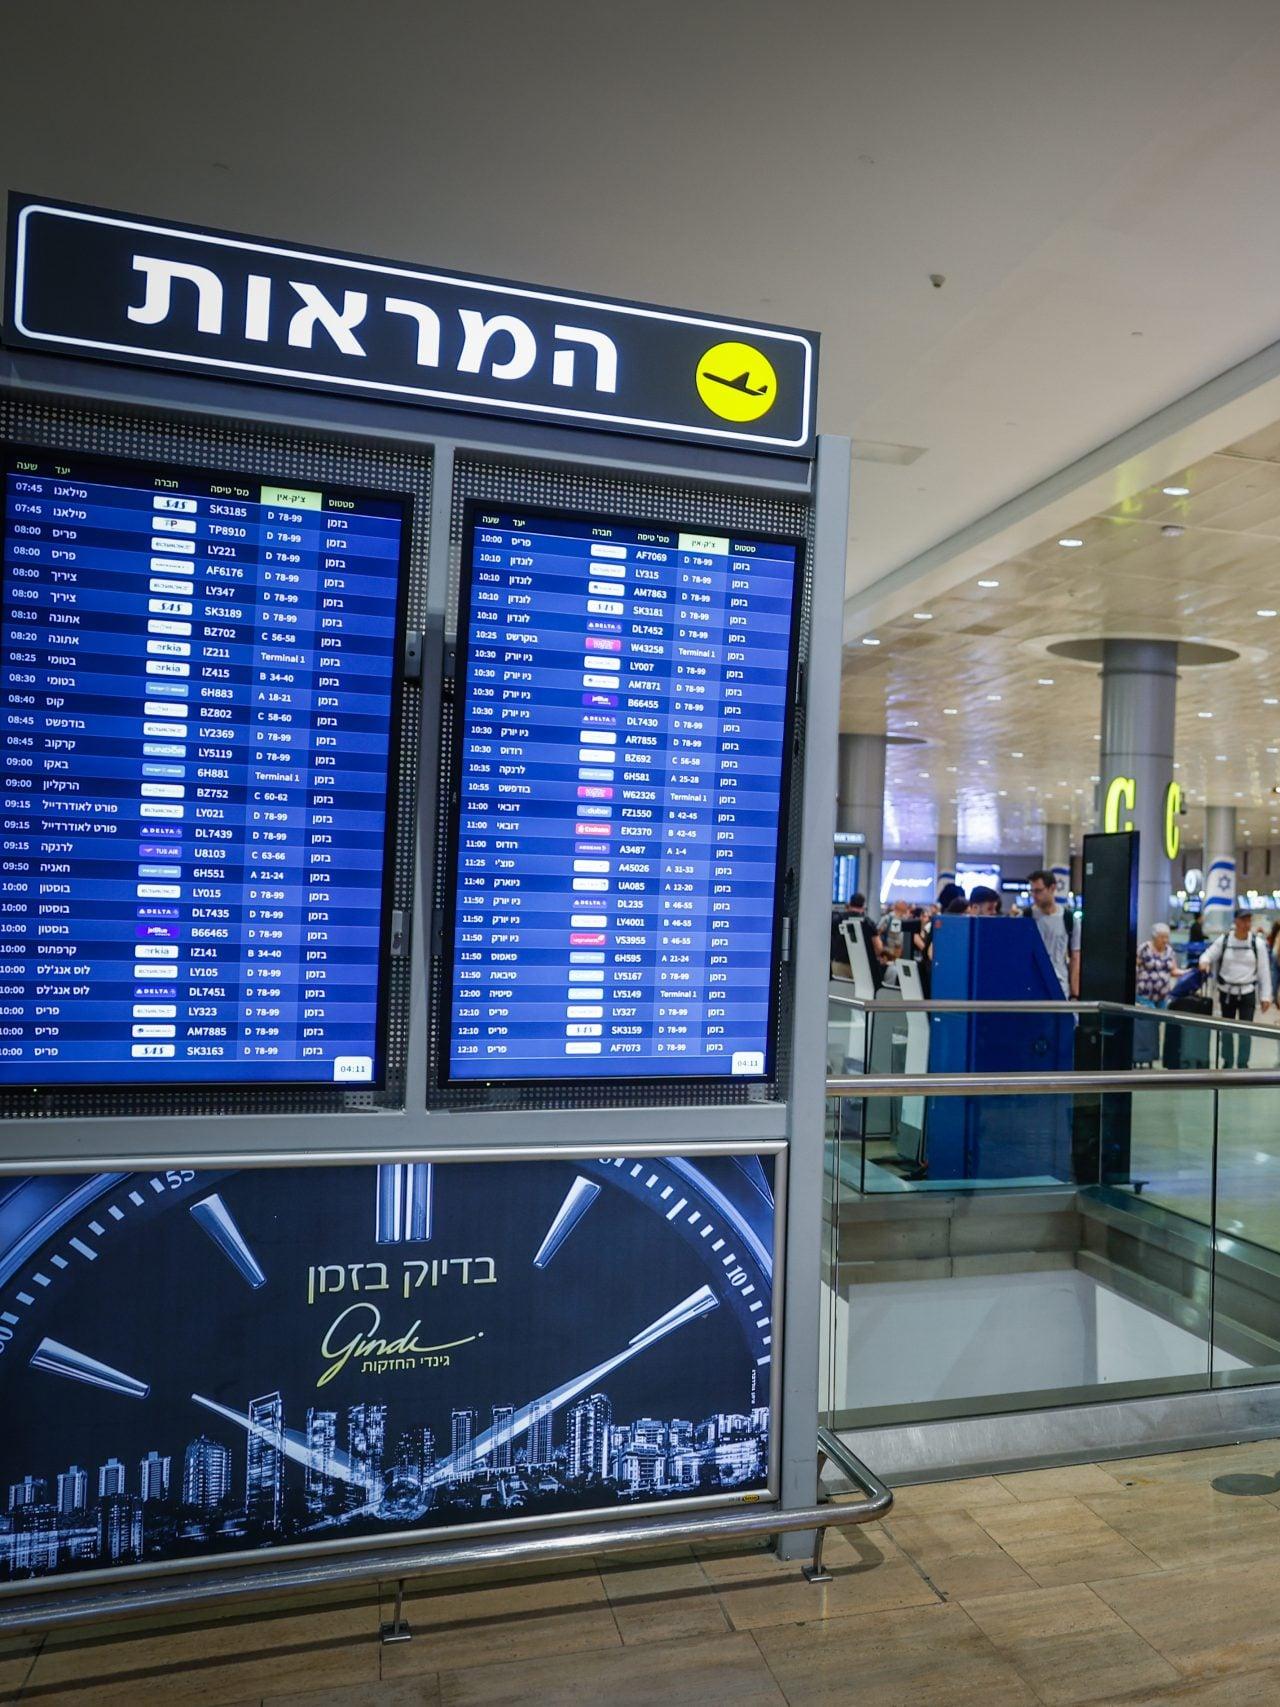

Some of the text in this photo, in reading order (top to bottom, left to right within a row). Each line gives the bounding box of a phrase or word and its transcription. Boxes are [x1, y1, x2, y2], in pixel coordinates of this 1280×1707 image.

[126, 254, 620, 394] המראות
[16, 461, 38, 471] שעה
[55, 465, 71, 474] יעד
[16, 482, 43, 493] 07:45
[154, 478, 179, 488] חברה
[54, 487, 87, 498] מילאנו
[210, 485, 232, 495] טיסה
[328, 499, 355, 509] סטטוס
[53, 508, 87, 519] מילאנו
[210, 504, 247, 517] SK3185
[268, 511, 302, 523] D 78-99
[482, 515, 500, 524] שעה
[327, 519, 348, 528] בזמן
[512, 519, 526, 527] יעד
[14, 525, 41, 535] 08:00
[52, 529, 77, 539] פריס
[208, 525, 246, 537] TP8910
[592, 527, 612, 537] חברה
[481, 534, 502, 543] 10:00
[511, 538, 531, 547] פריס
[637, 533, 655, 542] טיסה
[208, 545, 236, 557] LY221
[734, 544, 756, 553] סטטוס
[52, 550, 76, 560] פריס
[636, 551, 667, 562] AF7069
[510, 557, 533, 566] לונדון
[13, 568, 39, 578] 08:00
[51, 571, 77, 582] ציריך
[206, 566, 243, 578] AF6176
[635, 569, 659, 579] LY315
[206, 586, 235, 597] LY347
[634, 588, 667, 599] AM7863
[50, 592, 76, 603] ציריך
[11, 610, 37, 620] 08:10
[205, 607, 242, 618] SK3189
[633, 606, 663, 617] SK3181
[49, 614, 80, 624] אתונה
[204, 627, 236, 638] BZ702
[476, 630, 497, 639] 10:25
[632, 624, 663, 635] DL7452
[48, 635, 79, 645] אתונה
[506, 633, 538, 643] בוקרשט
[203, 647, 230, 658] IZ211
[631, 643, 664, 654] W43258
[10, 652, 36, 662] 08:25
[48, 656, 76, 666] בטומי
[260, 652, 305, 663] Terminal 1
[630, 662, 654, 671] LY007
[202, 667, 230, 678] IZ415
[260, 672, 294, 682] B 34-40
[47, 677, 75, 686] בטומי
[628, 680, 661, 690] AM7871
[201, 688, 233, 698] 6H883
[258, 692, 291, 702] A 18-21
[8, 694, 35, 704] 08:40
[46, 697, 64, 708] קוס
[628, 698, 659, 709] B66455
[200, 708, 232, 718] BZ802
[45, 718, 85, 728] בודפשט
[627, 717, 658, 727] DL7430
[199, 728, 234, 739] LY2369
[7, 736, 33, 746] 08:45
[45, 739, 76, 750] קרקוב
[625, 735, 657, 745] AR7855
[199, 748, 232, 758] LY5119
[625, 754, 651, 763] BZ692
[44, 760, 69, 770] באקו
[499, 765, 526, 774] לרנקה
[197, 768, 229, 778] 6H881
[255, 771, 300, 782] Terminal 1
[624, 772, 650, 781] 6H581
[5, 779, 32, 788] 09:00
[43, 779, 79, 791] הרקליון
[197, 788, 228, 798] BZ752
[623, 790, 656, 799] W62326
[42, 800, 118, 813] פורט לאודרדייל
[1105, 777, 1136, 833] C
[196, 808, 224, 818] LY021
[622, 808, 652, 817] FZ1550
[4, 820, 30, 829] 09:15
[1166, 781, 1180, 860] C
[42, 820, 117, 833] פורט לאודרדייל
[621, 826, 653, 835] EK2370
[195, 829, 233, 839] DL7439
[41, 842, 73, 853] לרנקה
[194, 848, 226, 858] U8103
[3, 862, 29, 870] 09:50
[40, 864, 70, 872] חאניה
[193, 869, 224, 878] 6H551
[40, 884, 70, 894] בוסטון
[193, 888, 221, 898] LY015
[2, 903, 27, 912] 10:00
[39, 905, 70, 914] בוסטון
[192, 908, 229, 918] DL7435
[38, 925, 69, 935] בוסטון
[191, 928, 228, 937] B66465
[38, 946, 77, 956] קרפתוס
[191, 948, 217, 957] IZ141
[74, 965, 90, 974] לוס
[190, 968, 218, 977] LY105
[73, 985, 90, 995] לוס
[189, 987, 225, 996] DL7451
[36, 1007, 60, 1015] פריס
[189, 1007, 217, 1016] LY323
[187, 1027, 227, 1036] AM7885
[187, 1047, 224, 1056] SK3163
[340, 1065, 365, 1073] 04:11
[166, 1170, 195, 1189] 55
[308, 1257, 497, 1304] בדיוק בזמן
[725, 1264, 747, 1287] 10
[361, 1355, 450, 1374] גינדי החזקות
